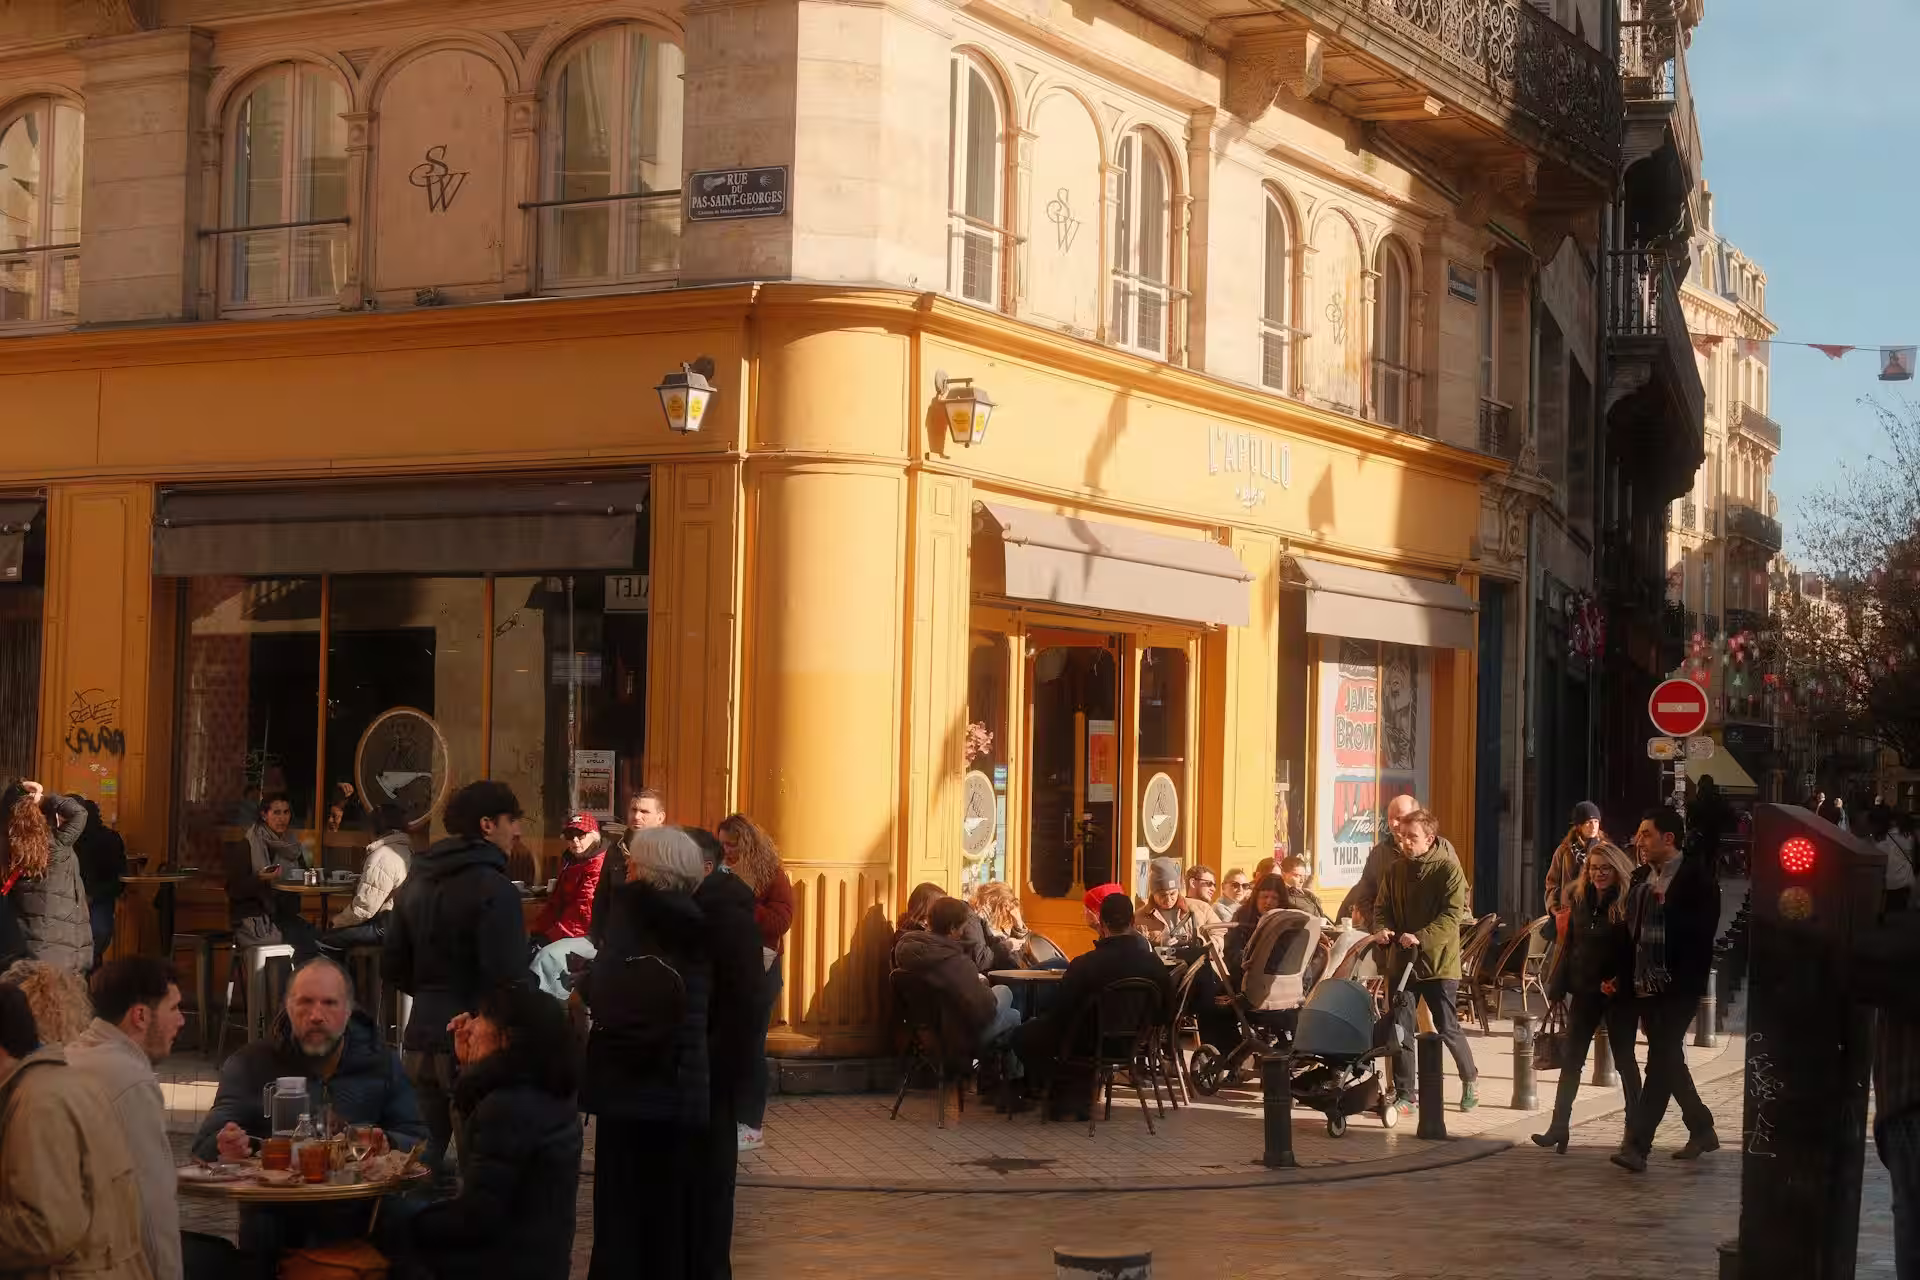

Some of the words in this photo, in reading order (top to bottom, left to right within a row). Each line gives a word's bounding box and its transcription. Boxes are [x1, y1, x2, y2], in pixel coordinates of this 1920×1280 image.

[727, 172, 749, 186] RUE
[731, 184, 743, 194] DU
[692, 190, 783, 209] PAS-SAINT-GEORGES
[1344, 685, 1377, 713] JAME
[1332, 846, 1362, 866] THUR.
